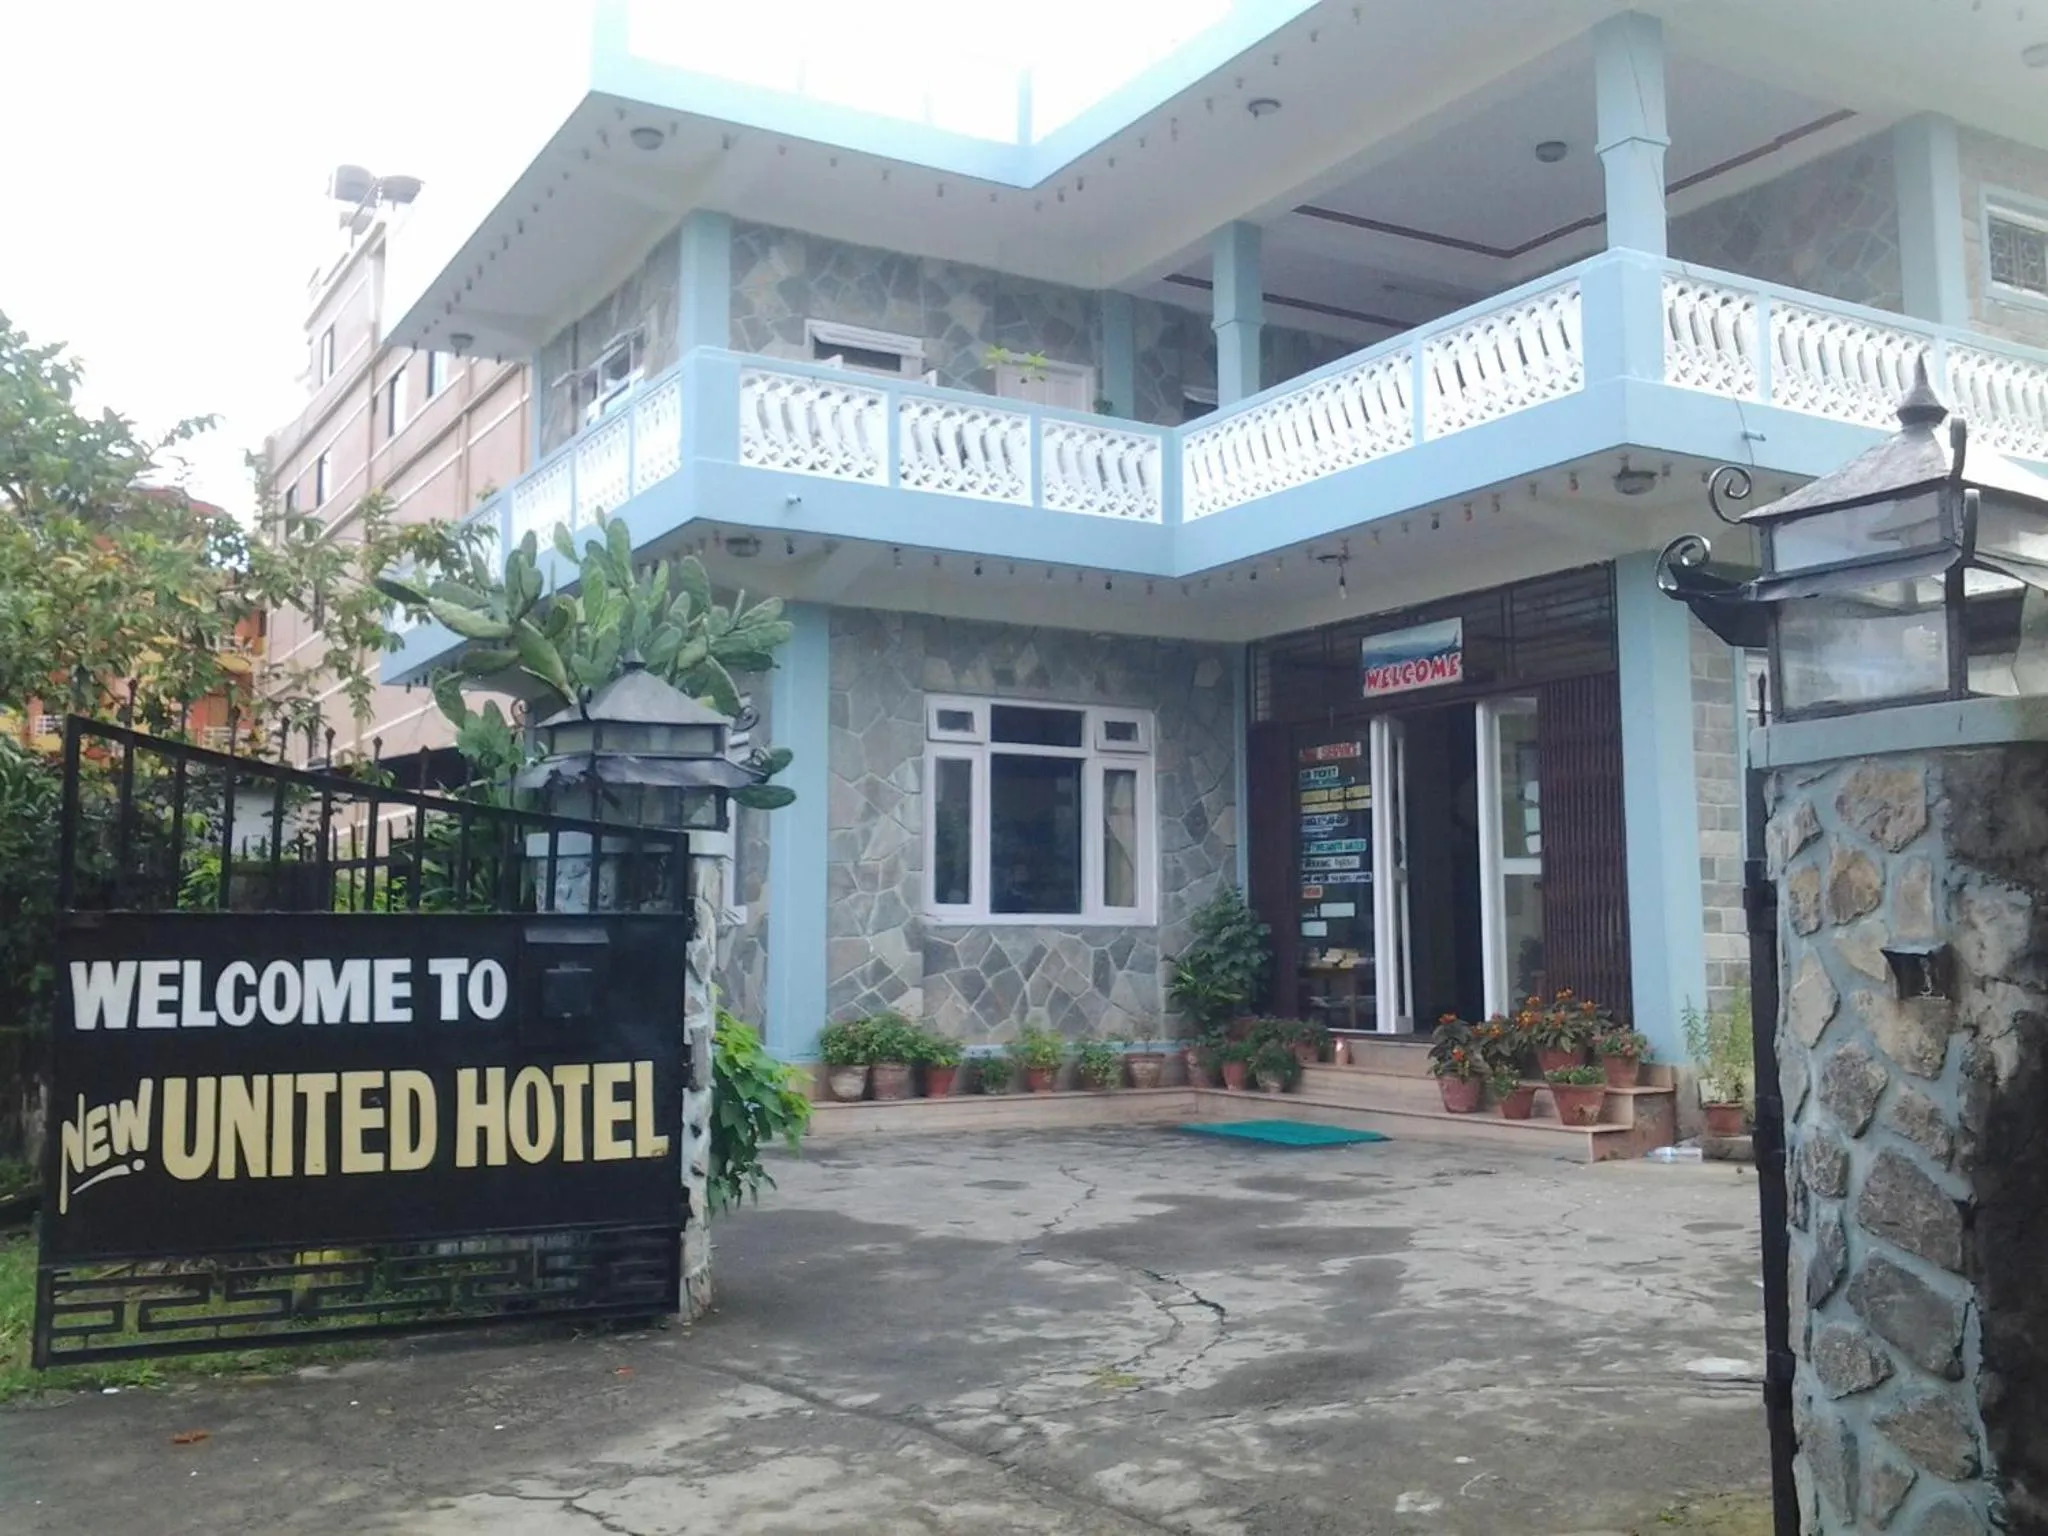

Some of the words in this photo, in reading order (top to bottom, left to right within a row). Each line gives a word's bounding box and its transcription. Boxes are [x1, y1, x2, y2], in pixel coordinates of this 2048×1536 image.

[1367, 655, 1459, 689] WELCOME
[70, 958, 412, 1029] WELCOME
[428, 957, 508, 1021] TO
[162, 1069, 438, 1181] UNITED
[455, 1060, 670, 1168] HOTEL
